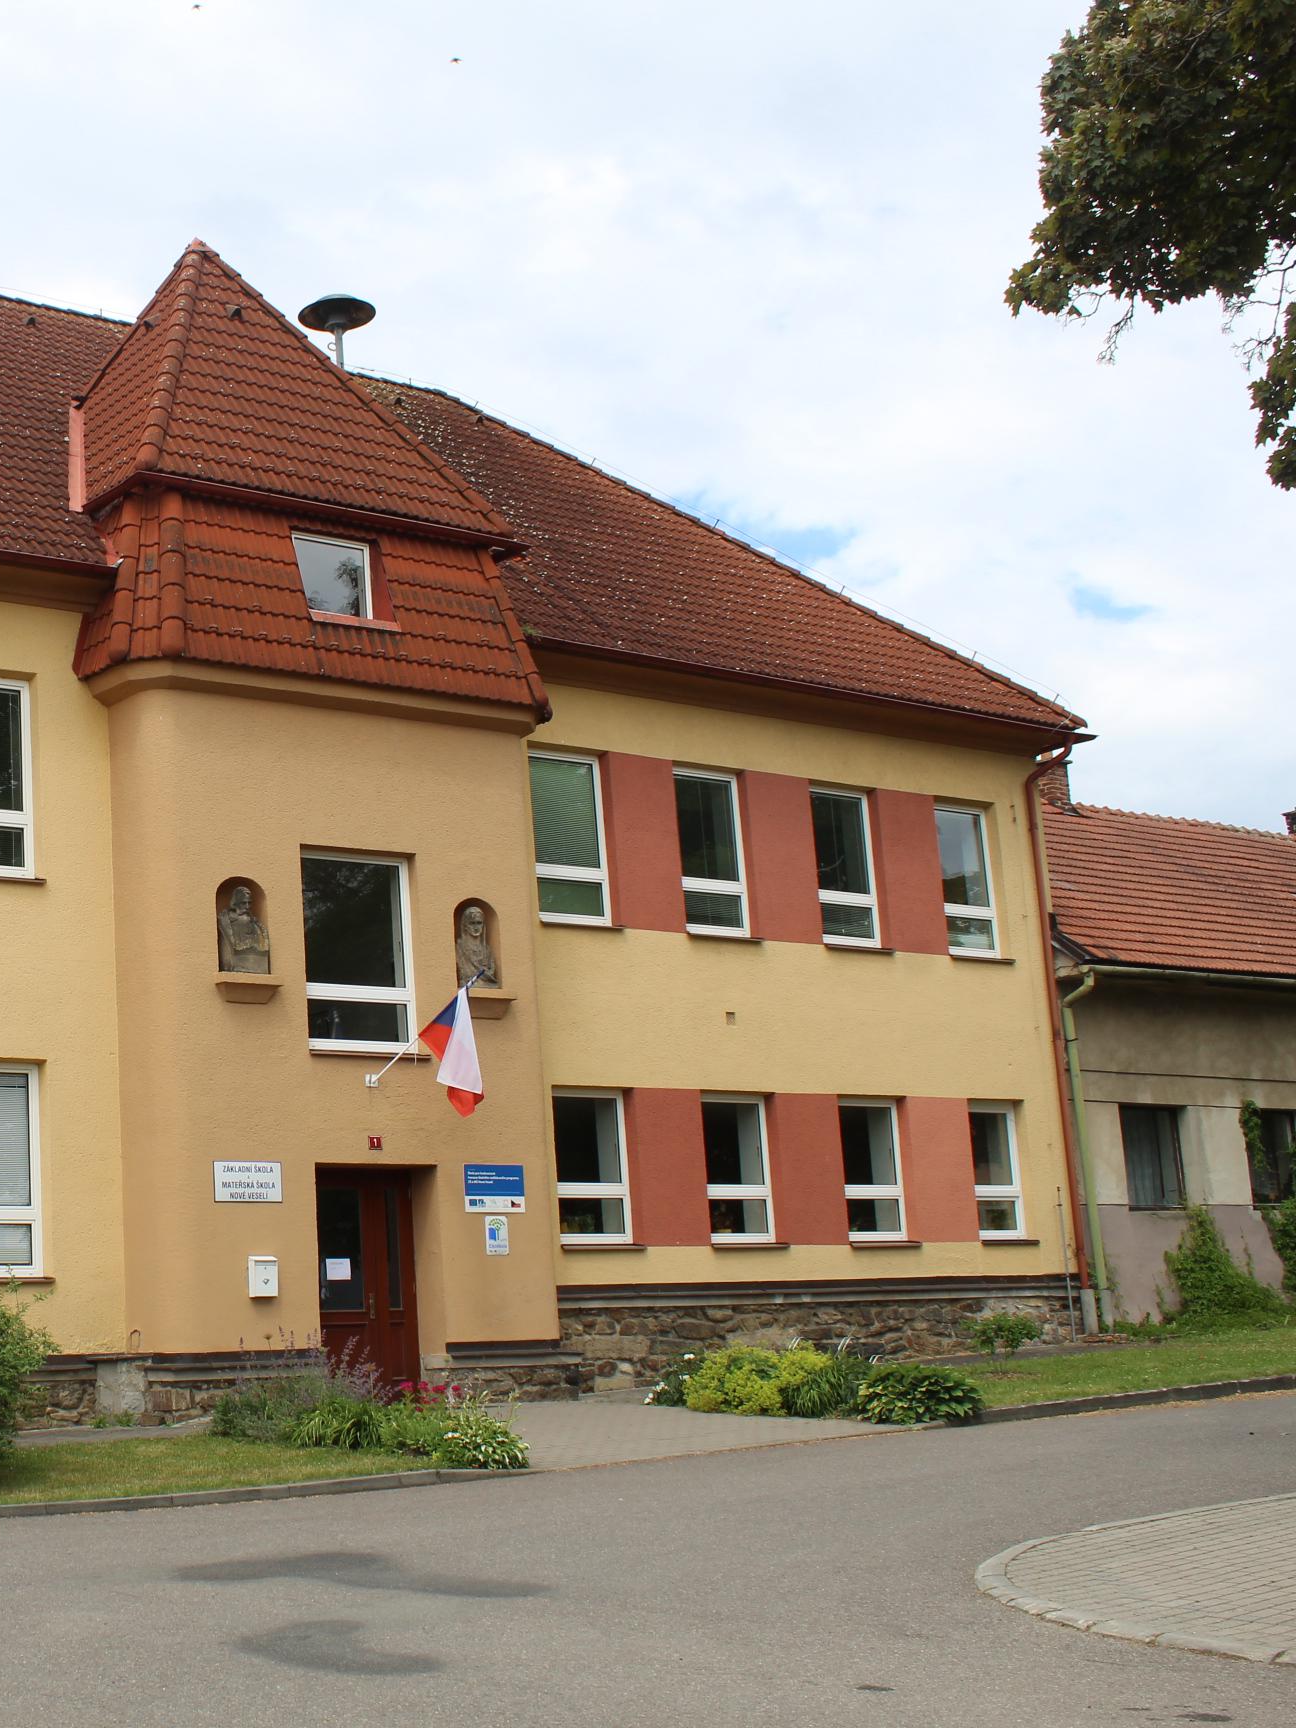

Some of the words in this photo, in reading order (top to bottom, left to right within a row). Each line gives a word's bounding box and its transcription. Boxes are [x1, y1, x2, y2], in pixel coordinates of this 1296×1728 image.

[222, 1164, 253, 1173] ZÁKLADNÍ
[254, 1164, 274, 1173] ŠKOLA
[221, 1180, 254, 1189] MATEŘSKÁ
[255, 1180, 276, 1189] ŠKOLA
[229, 1191, 247, 1200] NOVÉ
[248, 1191, 268, 1200] VESELÍ
